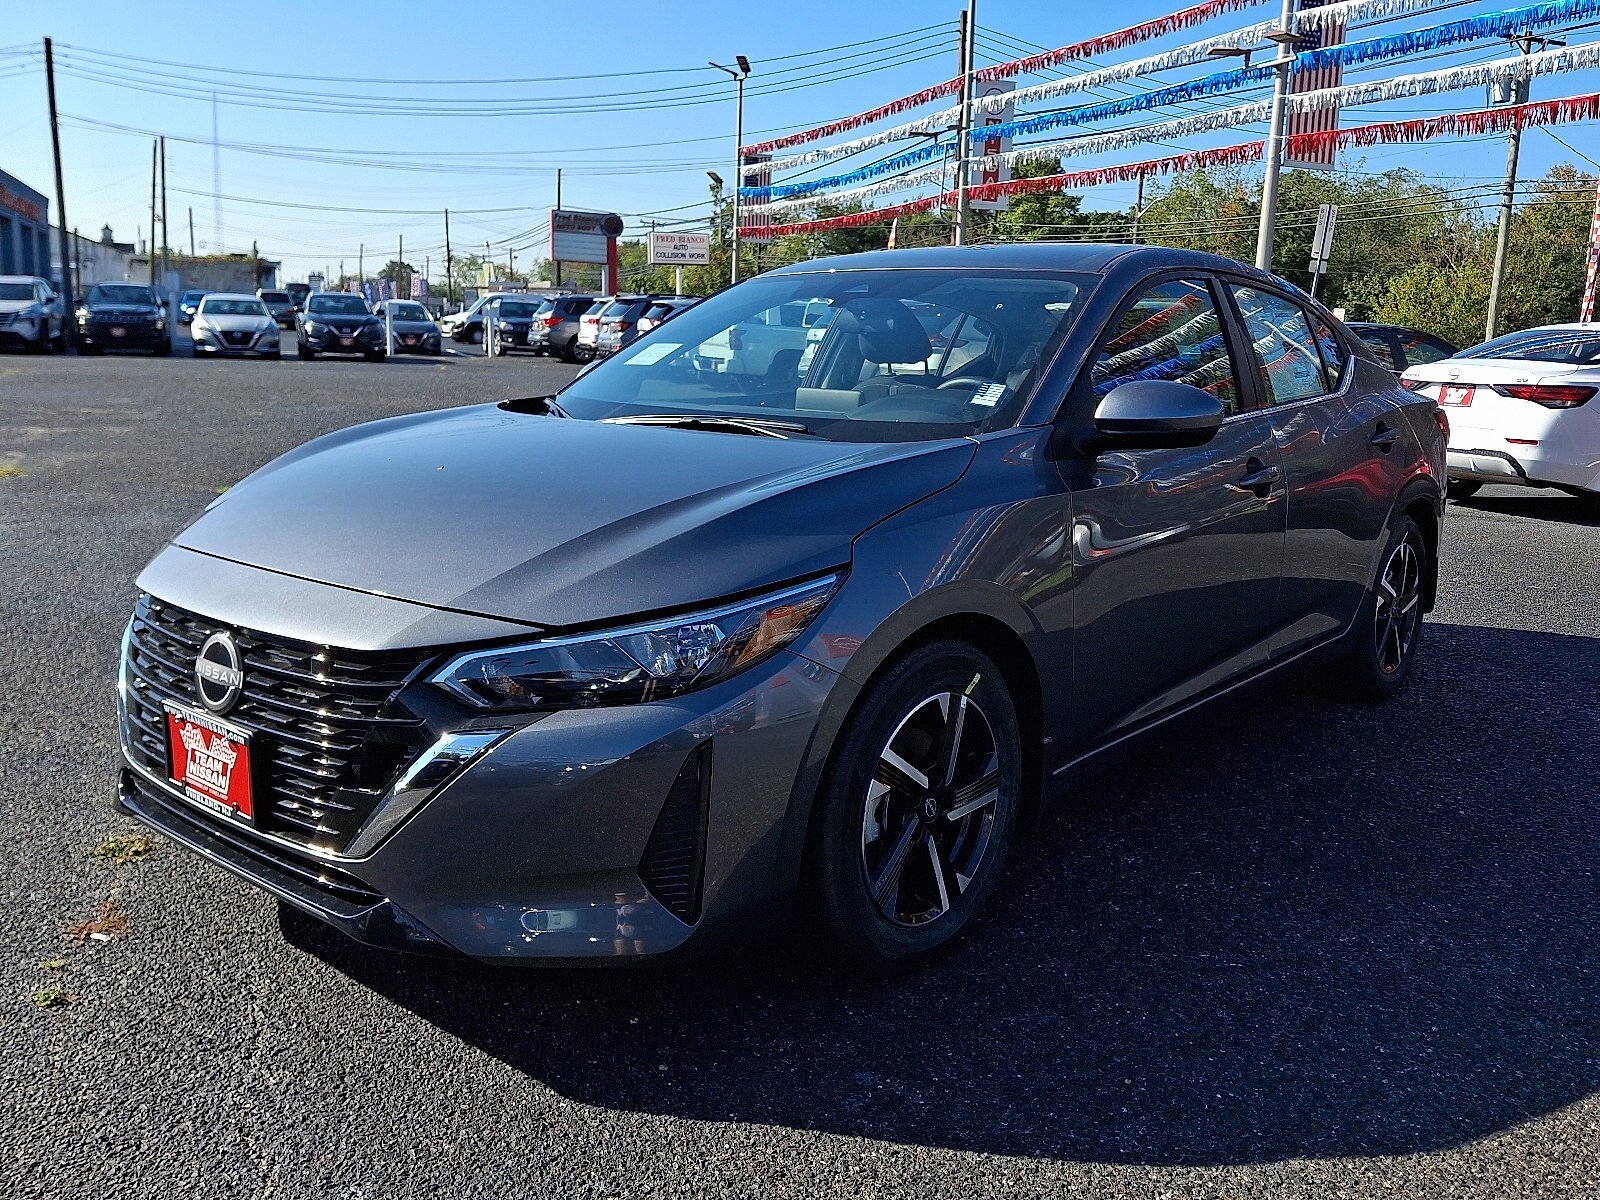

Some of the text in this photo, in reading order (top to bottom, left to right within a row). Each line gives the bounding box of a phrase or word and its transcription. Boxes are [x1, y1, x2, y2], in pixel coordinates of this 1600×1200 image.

[1328, 209, 1336, 232] STOP
[656, 235, 705, 244] FRED BIANCO
[656, 251, 706, 260] COLLISION WORK
[197, 658, 241, 686] NISSAN
[194, 750, 223, 774] TEAM
[189, 761, 226, 789] NISSAN
[221, 806, 232, 817] NJ
